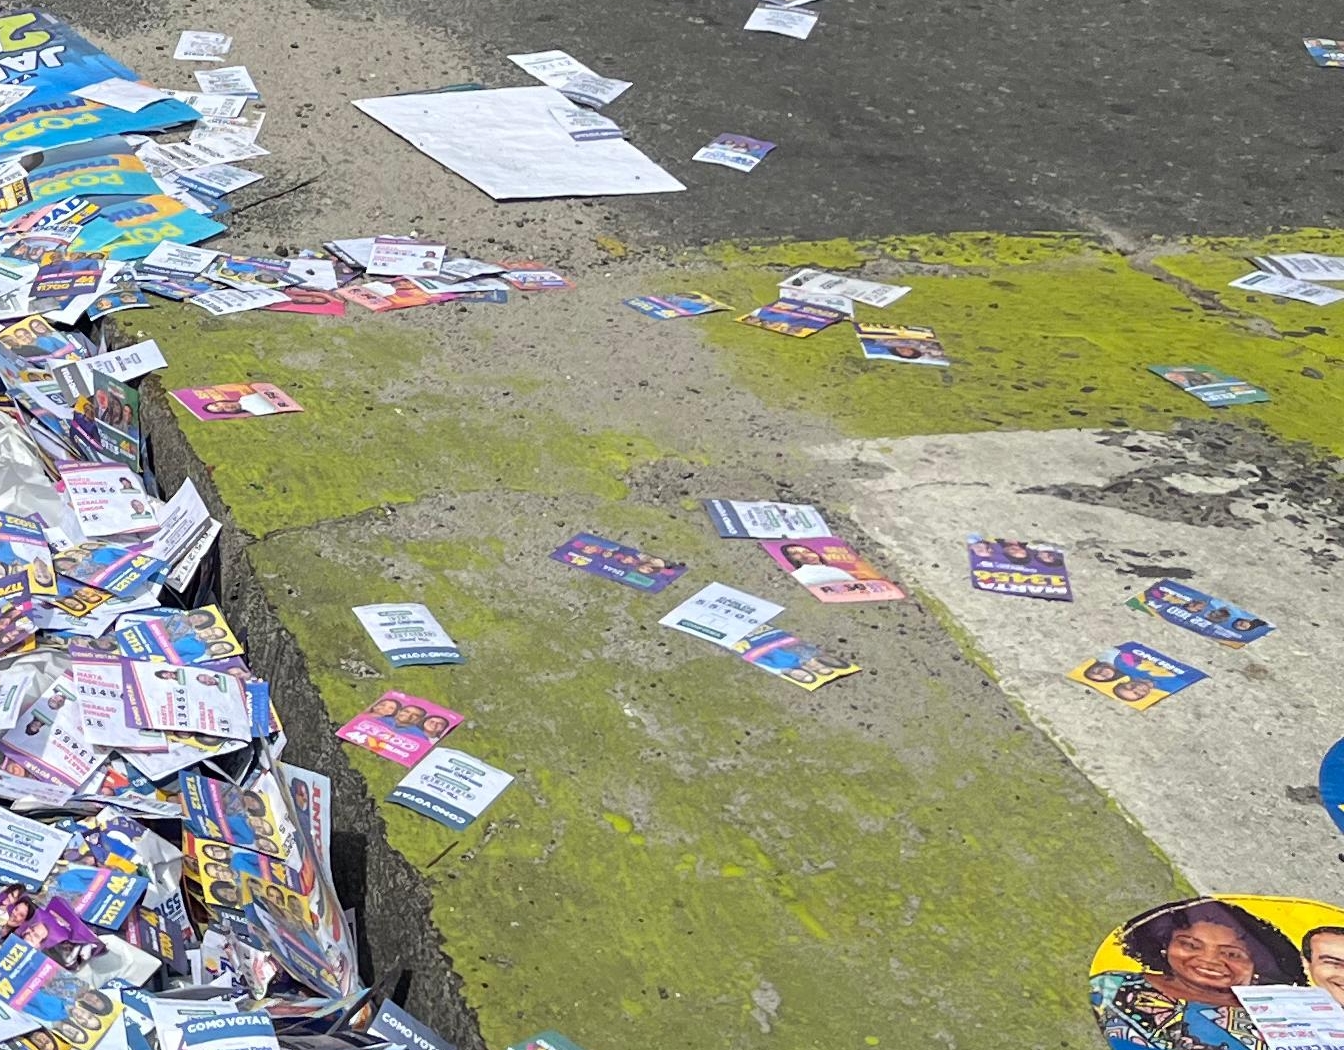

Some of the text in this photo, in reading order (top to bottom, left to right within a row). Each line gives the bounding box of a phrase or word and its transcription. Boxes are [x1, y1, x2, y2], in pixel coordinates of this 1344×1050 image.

[973, 570, 1064, 585] 13456
[977, 581, 1068, 595] MARTA
[1132, 648, 1186, 675] BRUNO
[393, 790, 465, 825] COMO VOTAR
[187, 1010, 270, 1034] COMO VOTAR
